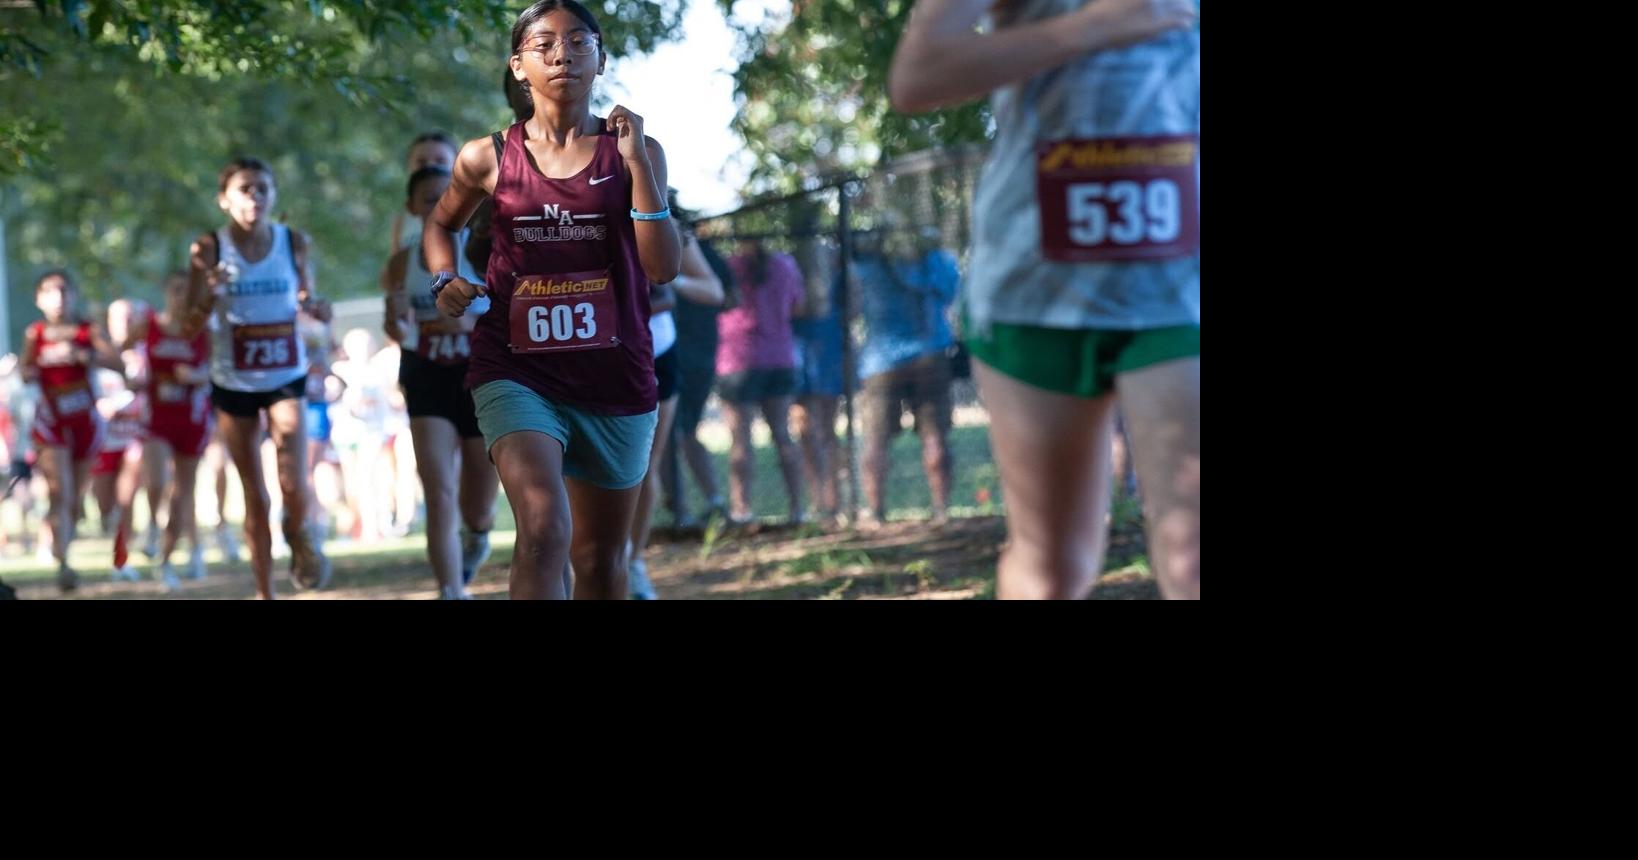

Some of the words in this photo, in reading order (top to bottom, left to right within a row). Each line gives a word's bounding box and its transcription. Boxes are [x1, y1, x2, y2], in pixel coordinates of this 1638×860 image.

[1067, 179, 1180, 245] 539
[513, 225, 607, 242] BULLDOGS
[513, 279, 583, 296] Athletic
[527, 302, 597, 343] 603
[243, 338, 289, 366] 736
[428, 334, 471, 360] 744
